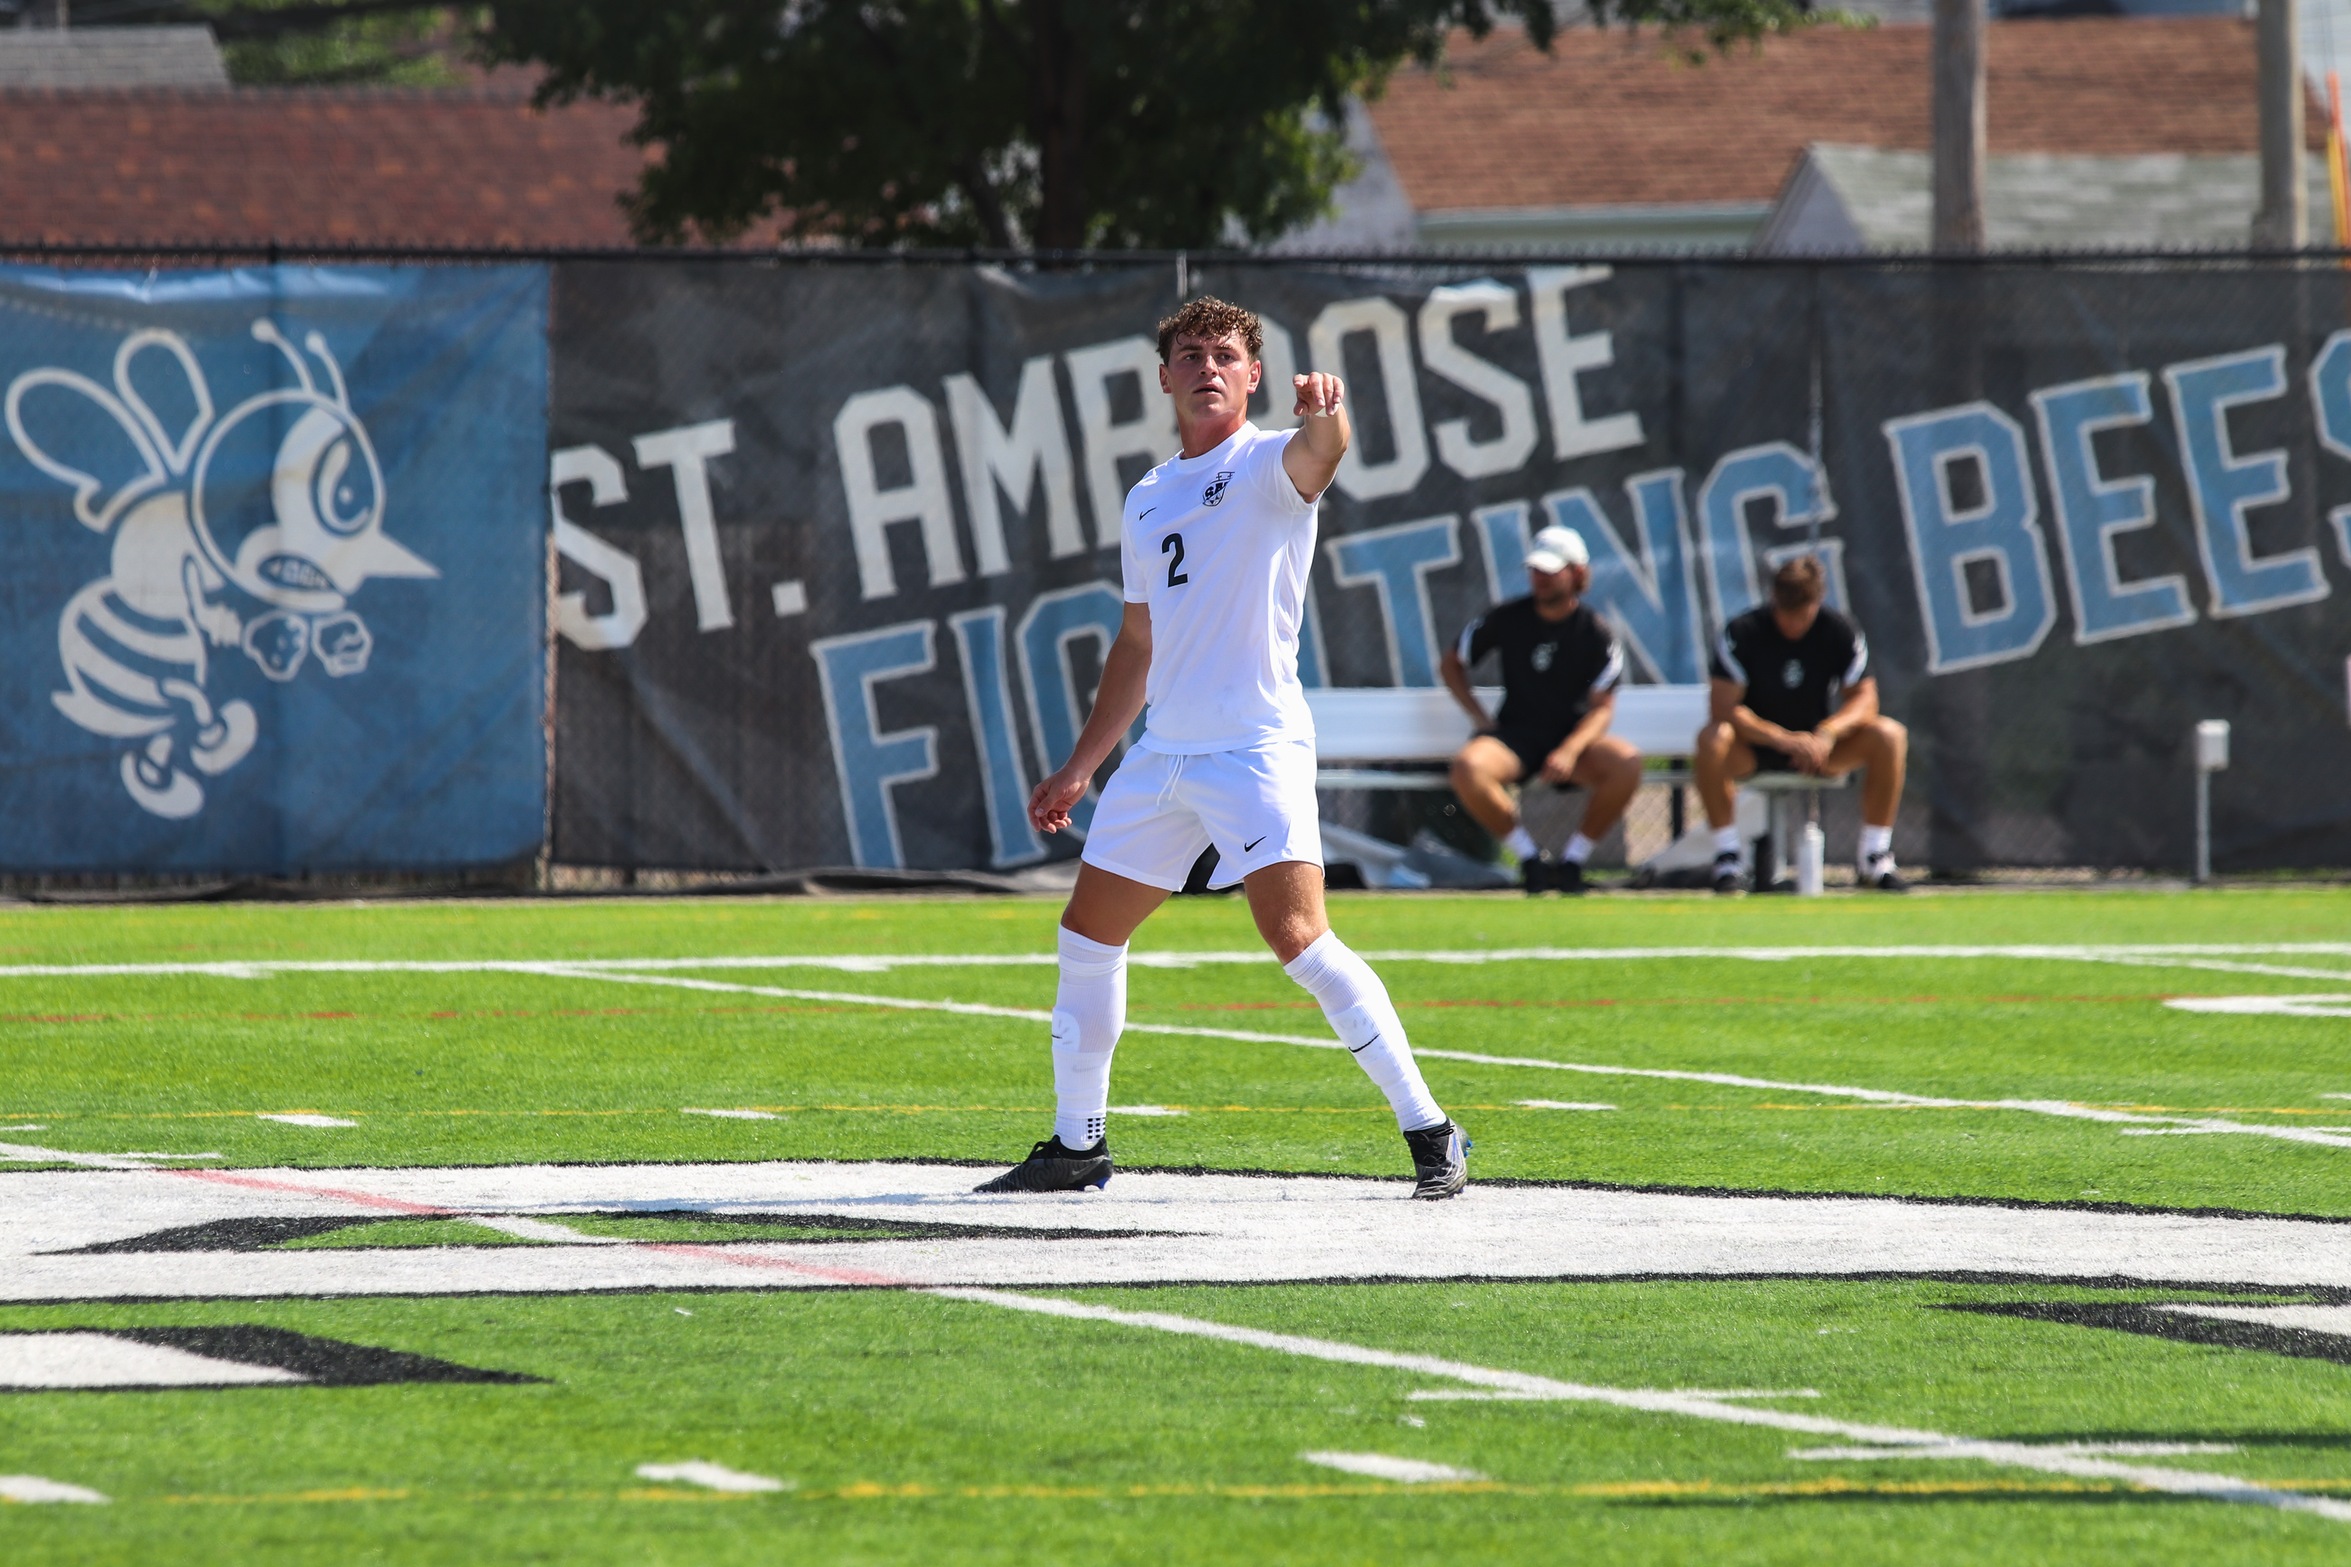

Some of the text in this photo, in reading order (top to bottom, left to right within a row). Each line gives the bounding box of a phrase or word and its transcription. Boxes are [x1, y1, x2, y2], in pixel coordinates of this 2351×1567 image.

[550, 266, 1646, 651] ST. AMBOSE
[1161, 533, 1188, 588] 2
[809, 441, 1850, 868] FIGTING
